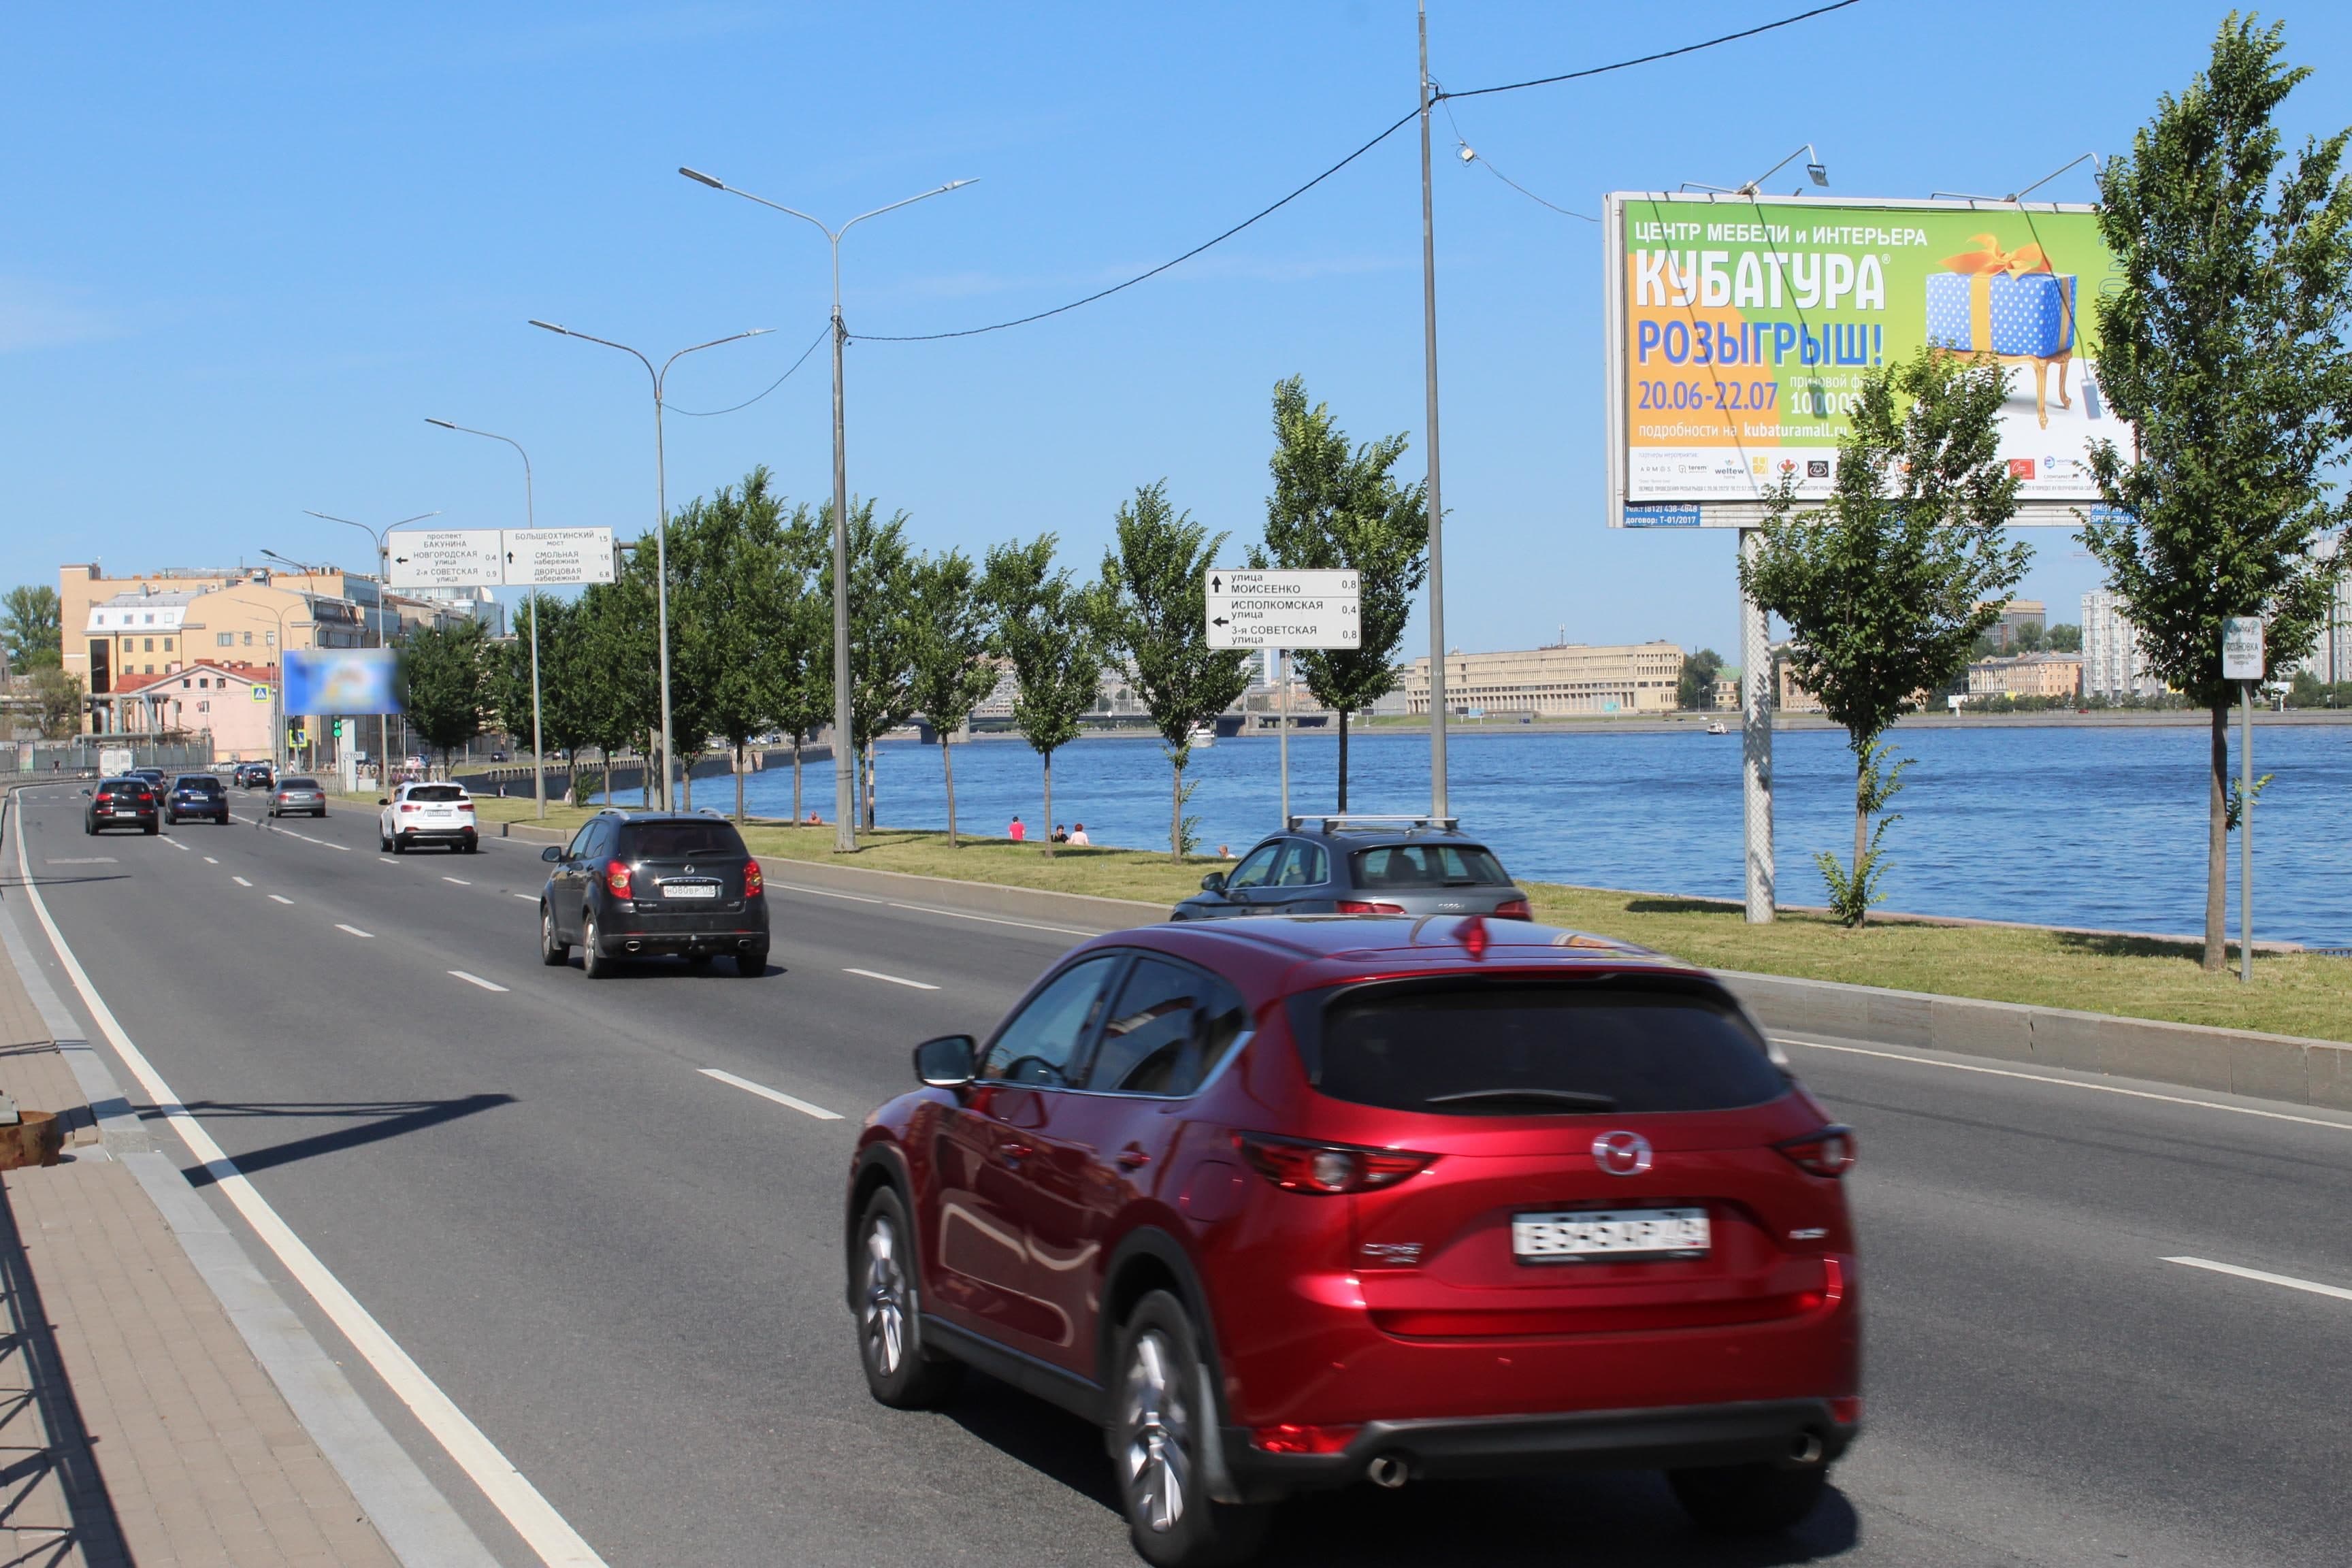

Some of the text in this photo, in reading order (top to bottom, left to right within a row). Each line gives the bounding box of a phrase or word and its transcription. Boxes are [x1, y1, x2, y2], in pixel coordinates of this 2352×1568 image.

[1635, 222, 1927, 246] ЦЕНТР МЕБЕЛИ и ИНТЕРЬЕРА
[1638, 321, 1884, 368] РОЗЫГРЫШ!
[1790, 374, 1846, 391] призовой
[1639, 380, 1778, 410] 20.06-22.07
[1639, 423, 1847, 440] подробности на kubaturamall.ru
[515, 532, 593, 540] БОЛЬШЕОХТИНСКИЙ
[414, 551, 477, 559] НОВГОРОДСКАЯ
[534, 568, 581, 576] ДВОРЦОВАЯ
[1231, 574, 1263, 583] улица
[1231, 585, 1301, 593] МОИСЕЕНКО
[1341, 580, 1356, 590] 0,8
[1231, 601, 1356, 615] ИСПОЛКОМСКАЯ 0,4
[1231, 611, 1263, 620] улица
[1232, 626, 1357, 640] 3-я СОВЕТСКАЯ 0,8
[1231, 636, 1263, 645] улица
